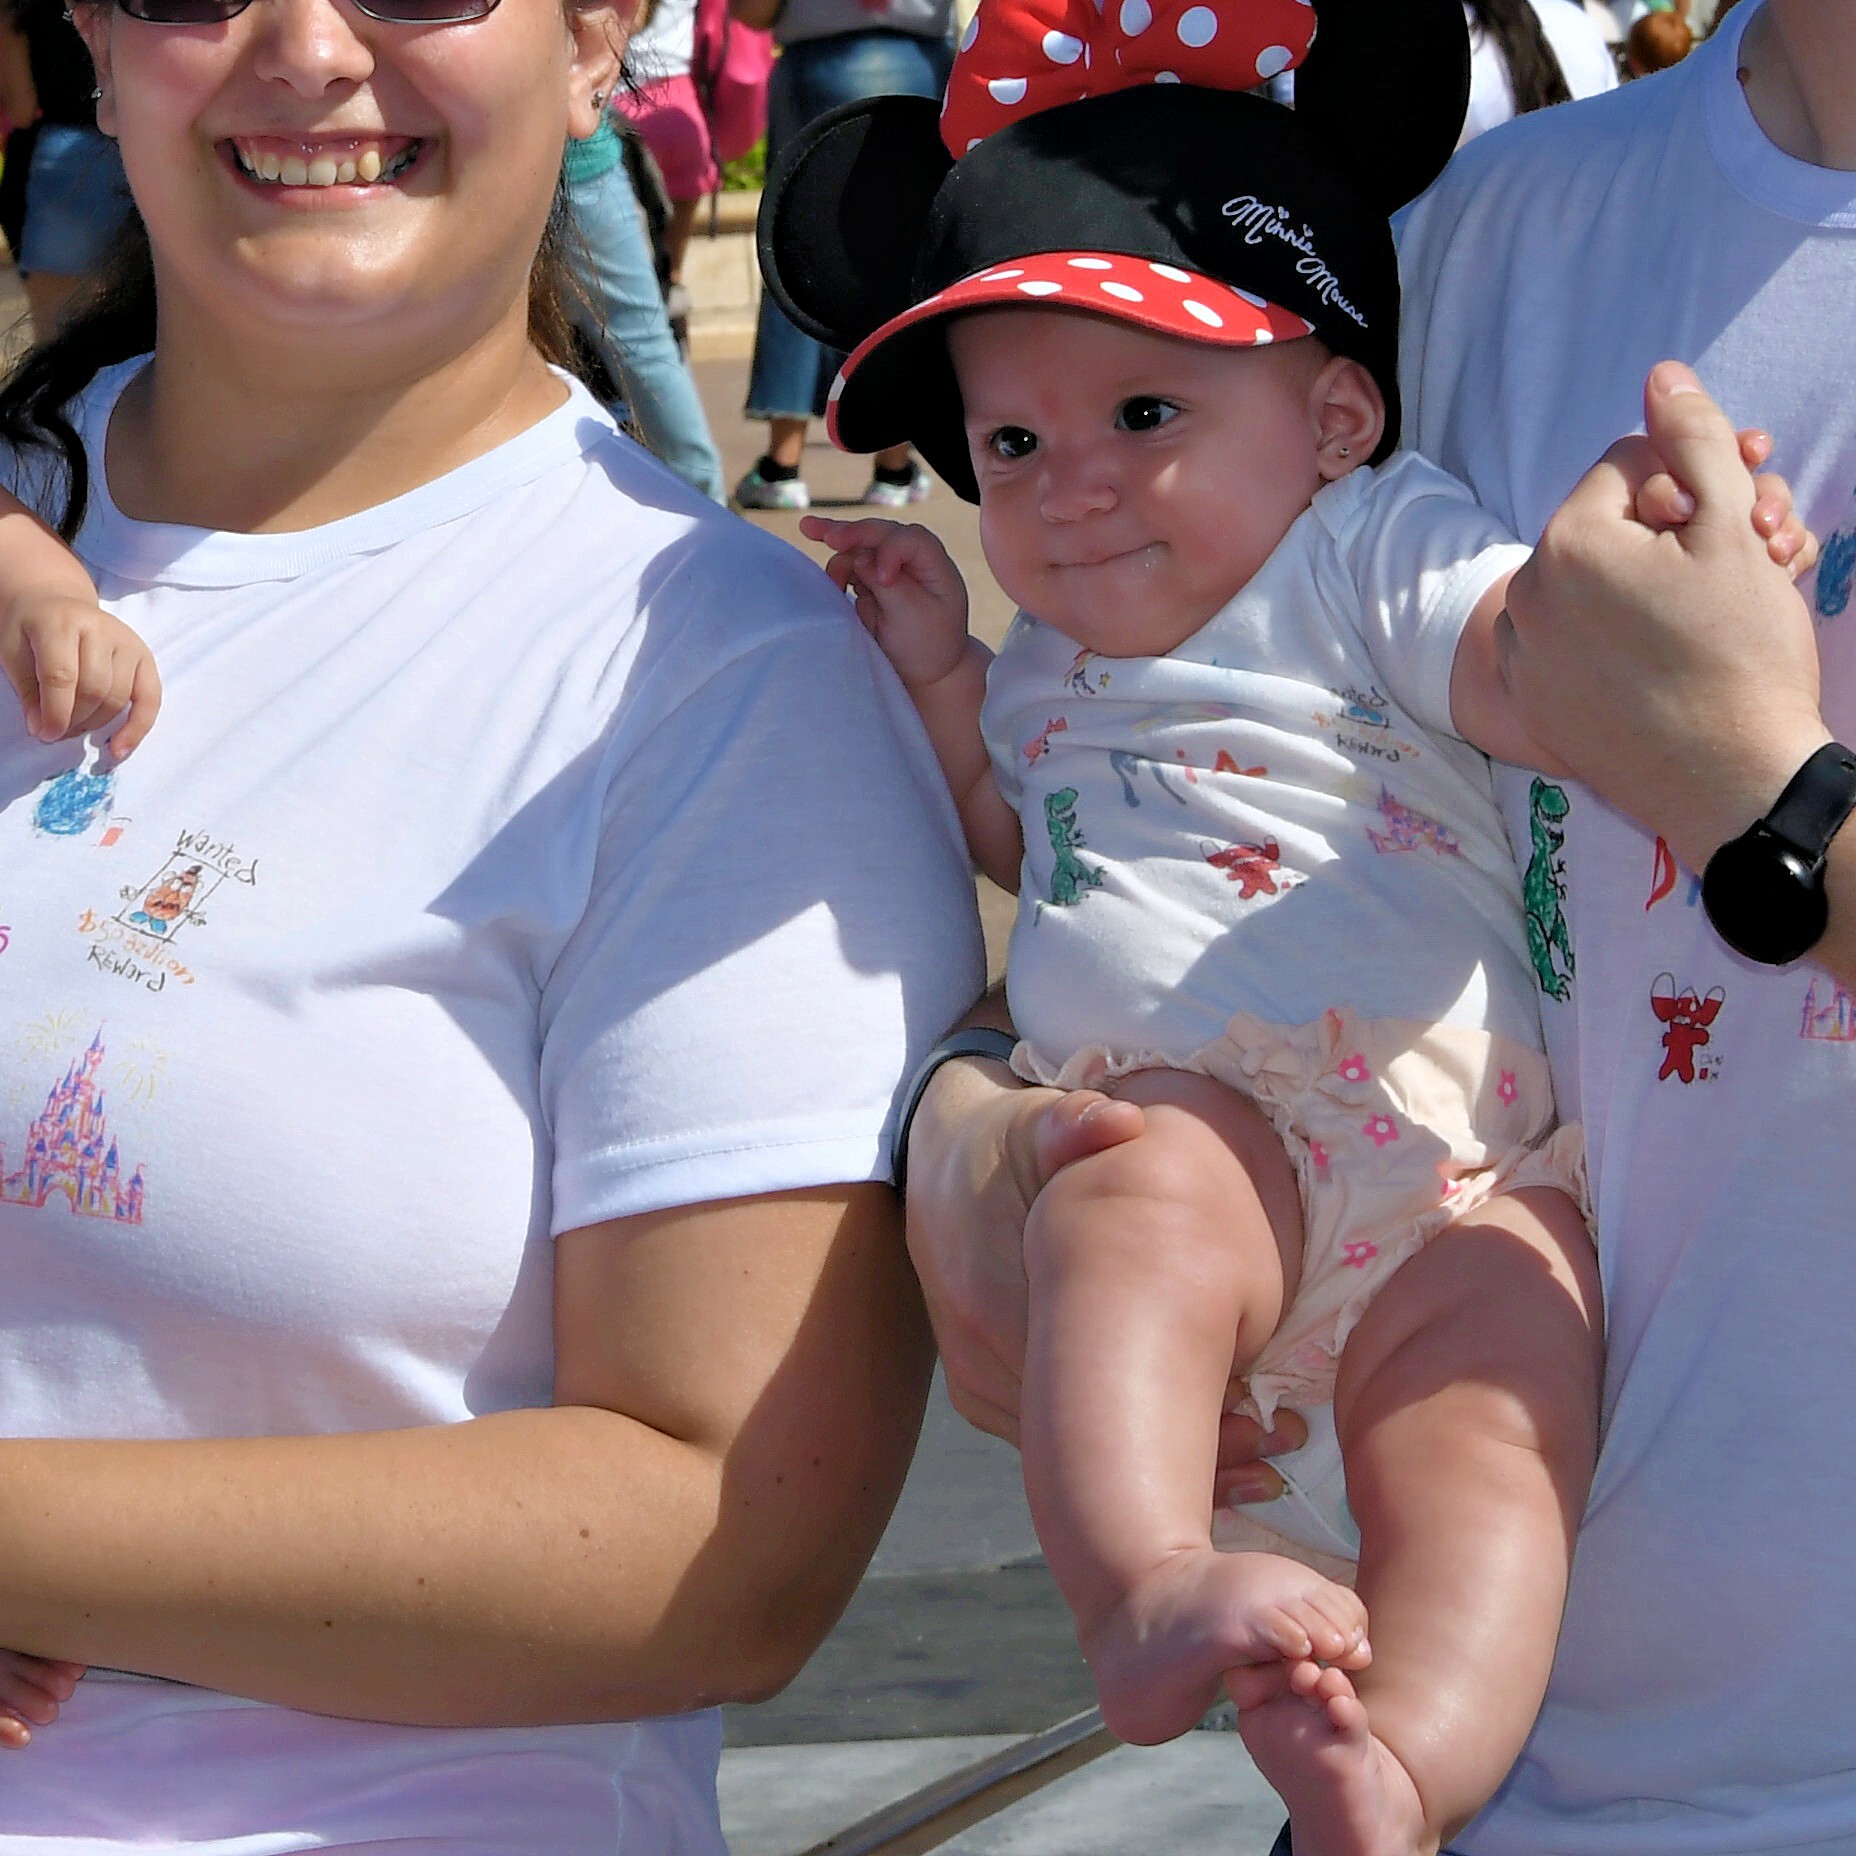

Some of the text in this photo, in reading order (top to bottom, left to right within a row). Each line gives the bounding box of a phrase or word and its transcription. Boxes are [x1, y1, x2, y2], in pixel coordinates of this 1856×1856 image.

[1222, 195, 1369, 328] Minnie Mouse
[176, 829, 259, 886] Wanted
